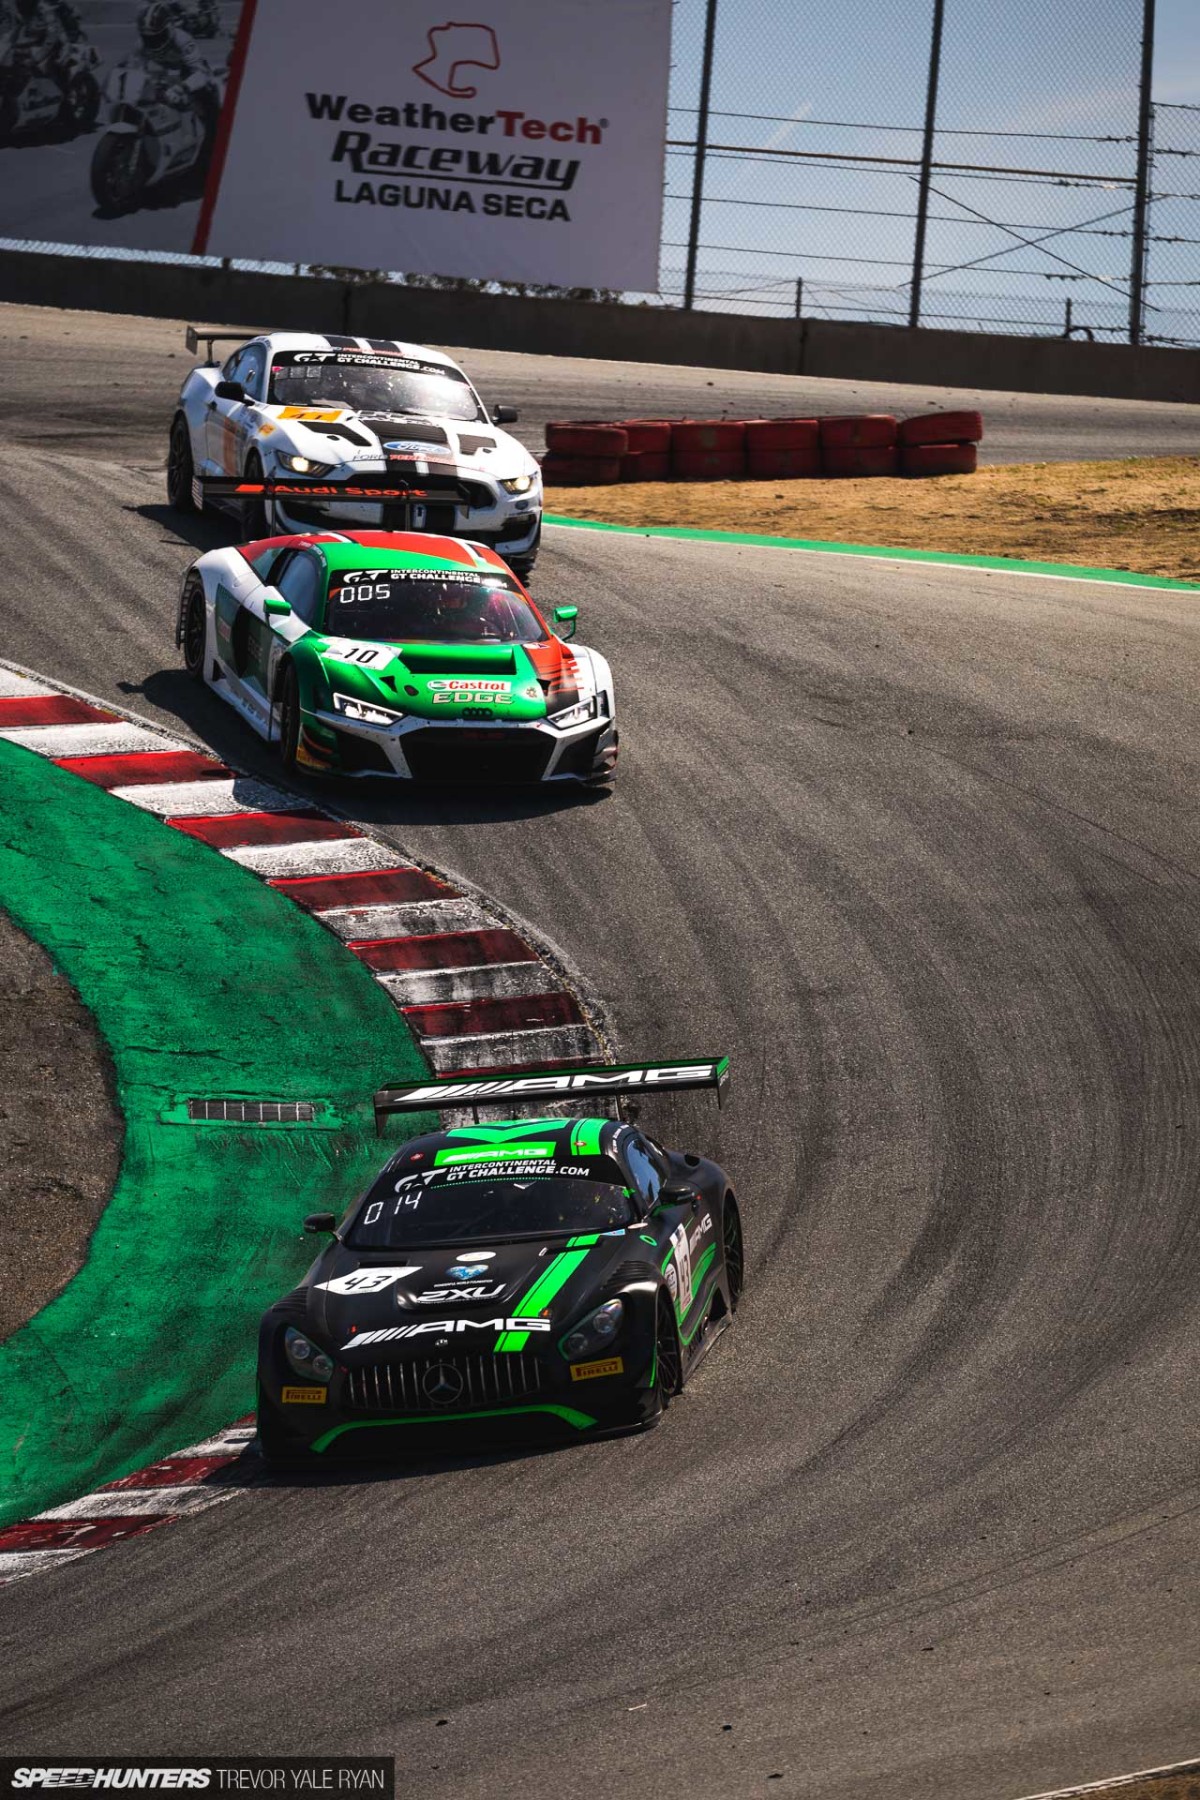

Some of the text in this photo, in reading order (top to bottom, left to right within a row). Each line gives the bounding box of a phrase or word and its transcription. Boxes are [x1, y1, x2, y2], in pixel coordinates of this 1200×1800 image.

[305, 92, 601, 145] WeatherTech
[331, 130, 580, 191] Raceway
[334, 179, 571, 222] LAGUNA SECA
[337, 353, 421, 366] INTERCONTINENTAL
[275, 485, 428, 497] Audi Sport
[390, 569, 479, 578] INTERCONTINENTAL
[340, 584, 391, 604] 005
[344, 647, 379, 664] 10
[448, 680, 507, 692] Castrol
[432, 692, 514, 704] EDGE
[446, 1165, 590, 1181] GT CHALLENGE.COM
[449, 1158, 557, 1173] INTERCONTINENTAL
[344, 1276, 393, 1291] 43
[417, 1283, 507, 1302] 2XU
[575, 1360, 618, 1378] PIRELLI
[286, 1388, 323, 1401] PIRELLI
